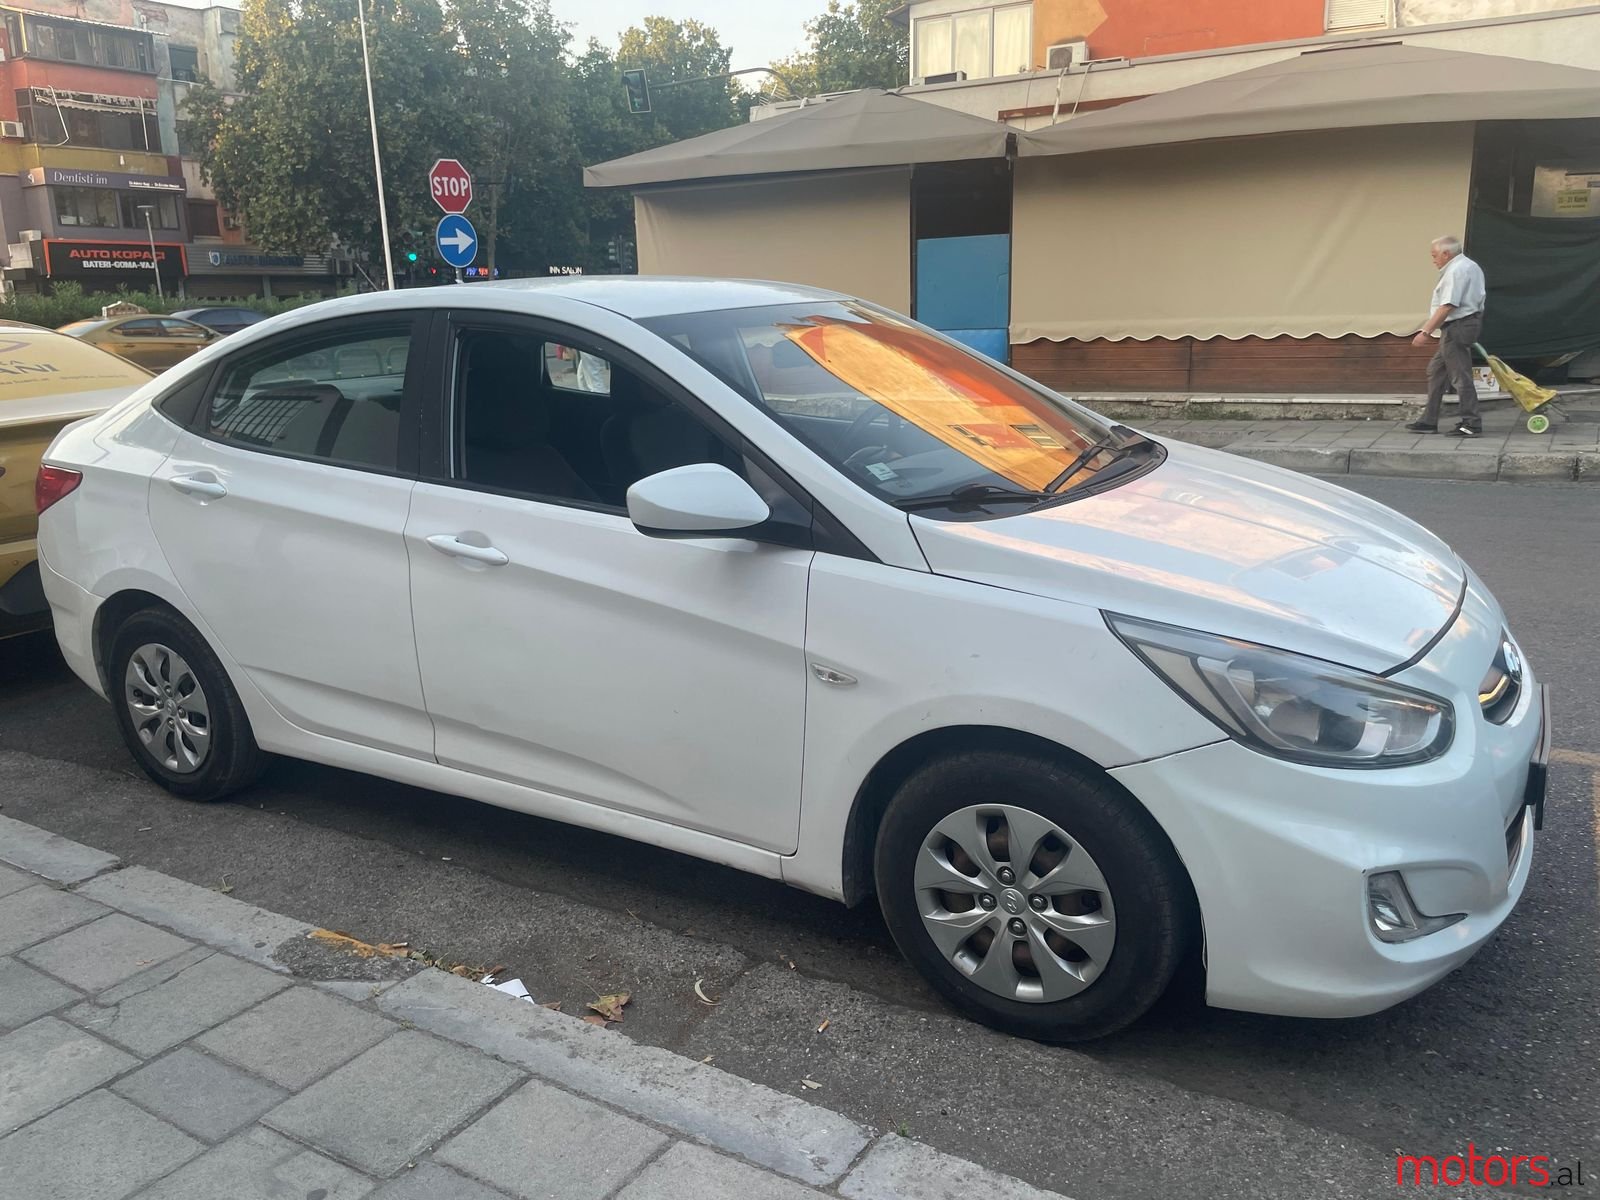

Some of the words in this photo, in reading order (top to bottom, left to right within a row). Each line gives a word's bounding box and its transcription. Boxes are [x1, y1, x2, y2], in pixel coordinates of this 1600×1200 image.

[54, 171, 93, 184] Dentisti
[96, 174, 108, 185] im
[433, 176, 468, 197] STOP
[69, 249, 110, 258] AUTO
